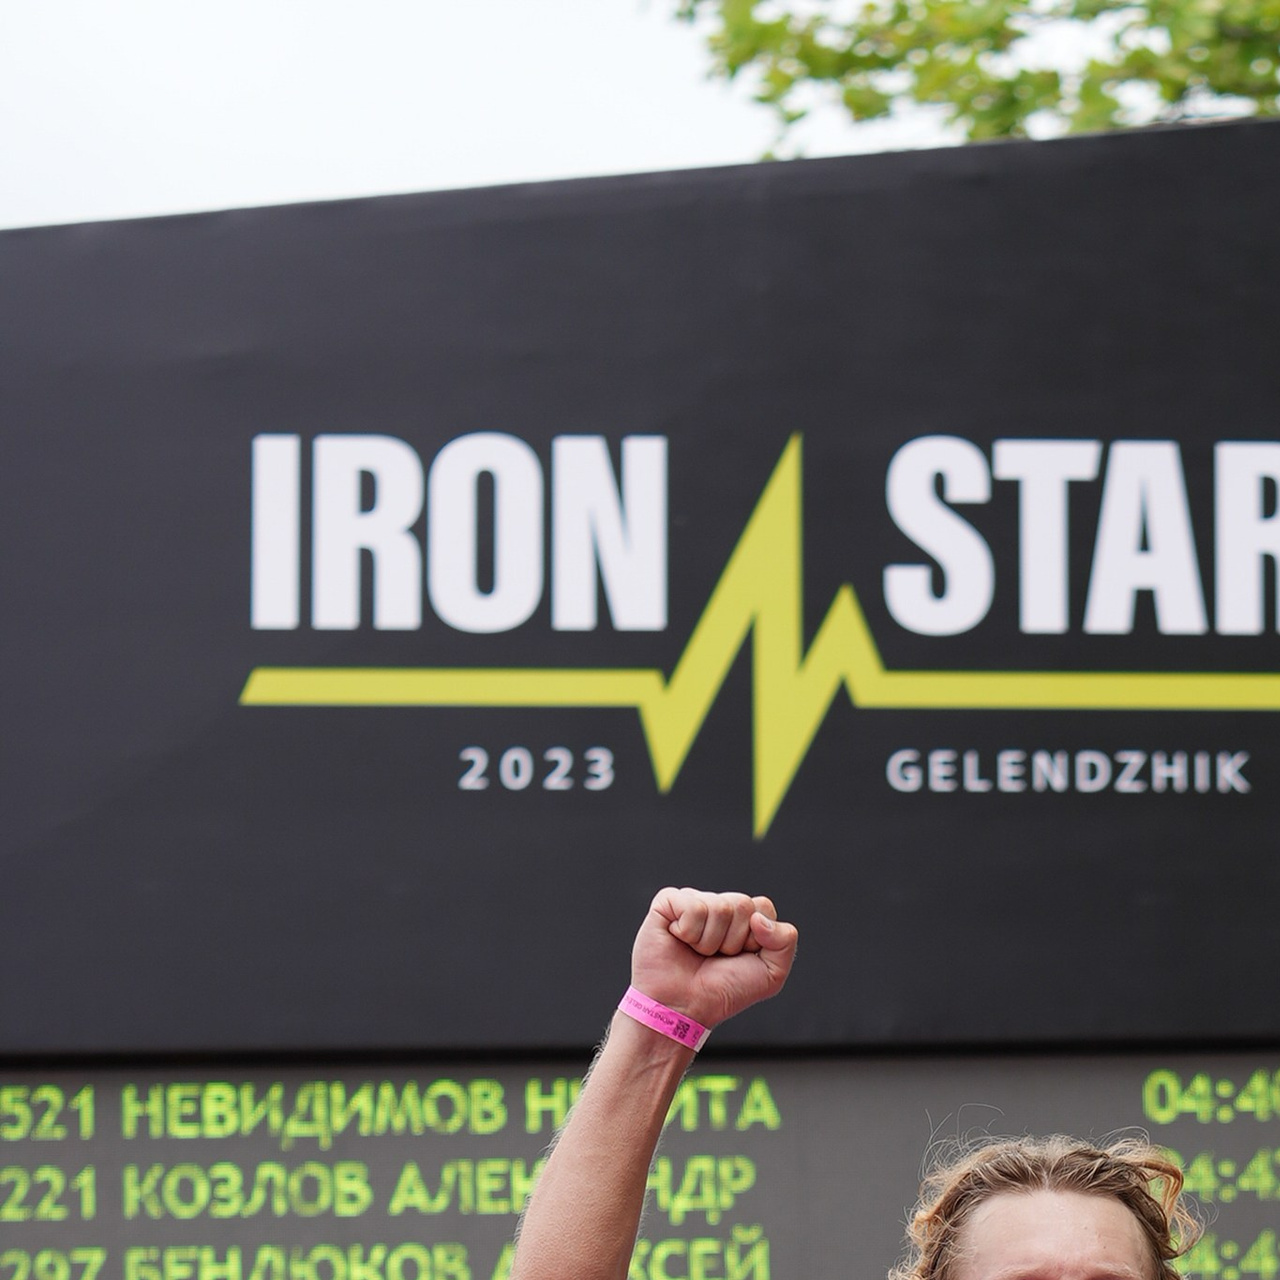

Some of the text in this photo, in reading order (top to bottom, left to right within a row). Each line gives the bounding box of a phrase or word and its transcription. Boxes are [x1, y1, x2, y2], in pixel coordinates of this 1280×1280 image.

[250, 432, 667, 632] IRON
[458, 746, 615, 790] 2023
[886, 749, 1251, 793] GELENDZHIK
[0, 1084, 96, 1141] 521
[121, 1080, 507, 1150] НЕВИДИМОВ
[0, 1164, 97, 1222] 221
[123, 1160, 374, 1220] КОЗЛОВ
